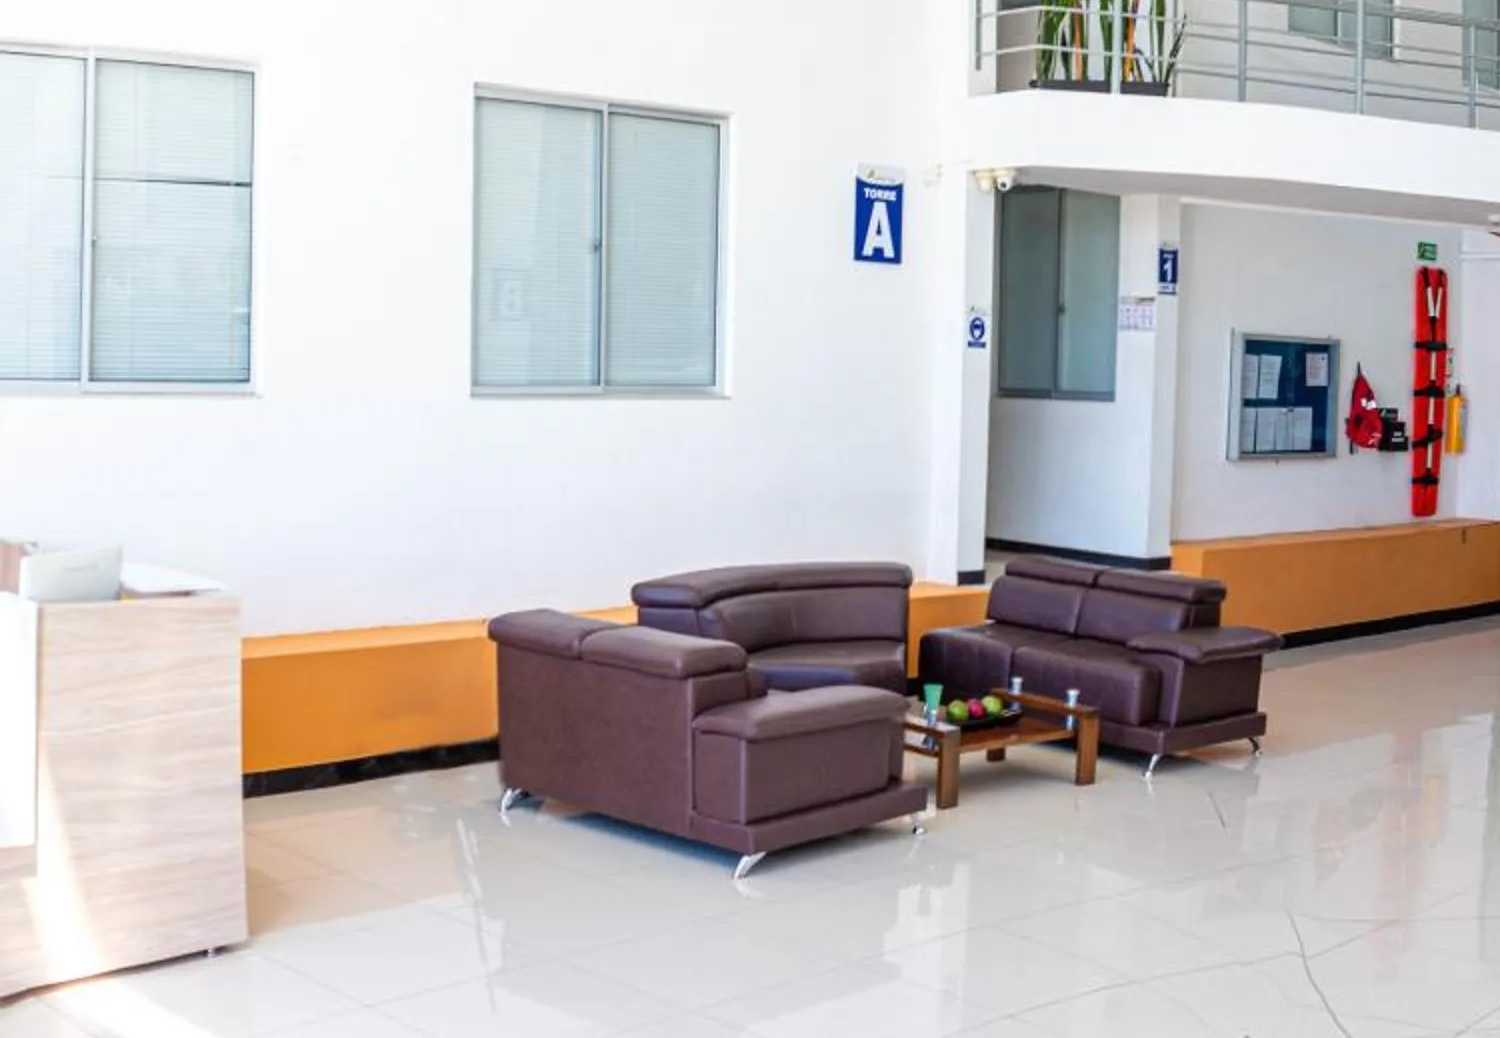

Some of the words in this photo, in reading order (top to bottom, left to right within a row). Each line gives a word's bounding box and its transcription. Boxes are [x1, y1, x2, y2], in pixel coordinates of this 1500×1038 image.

[864, 187, 896, 202] TORRE
[861, 201, 895, 259] A
[1163, 259, 1173, 282] 1
